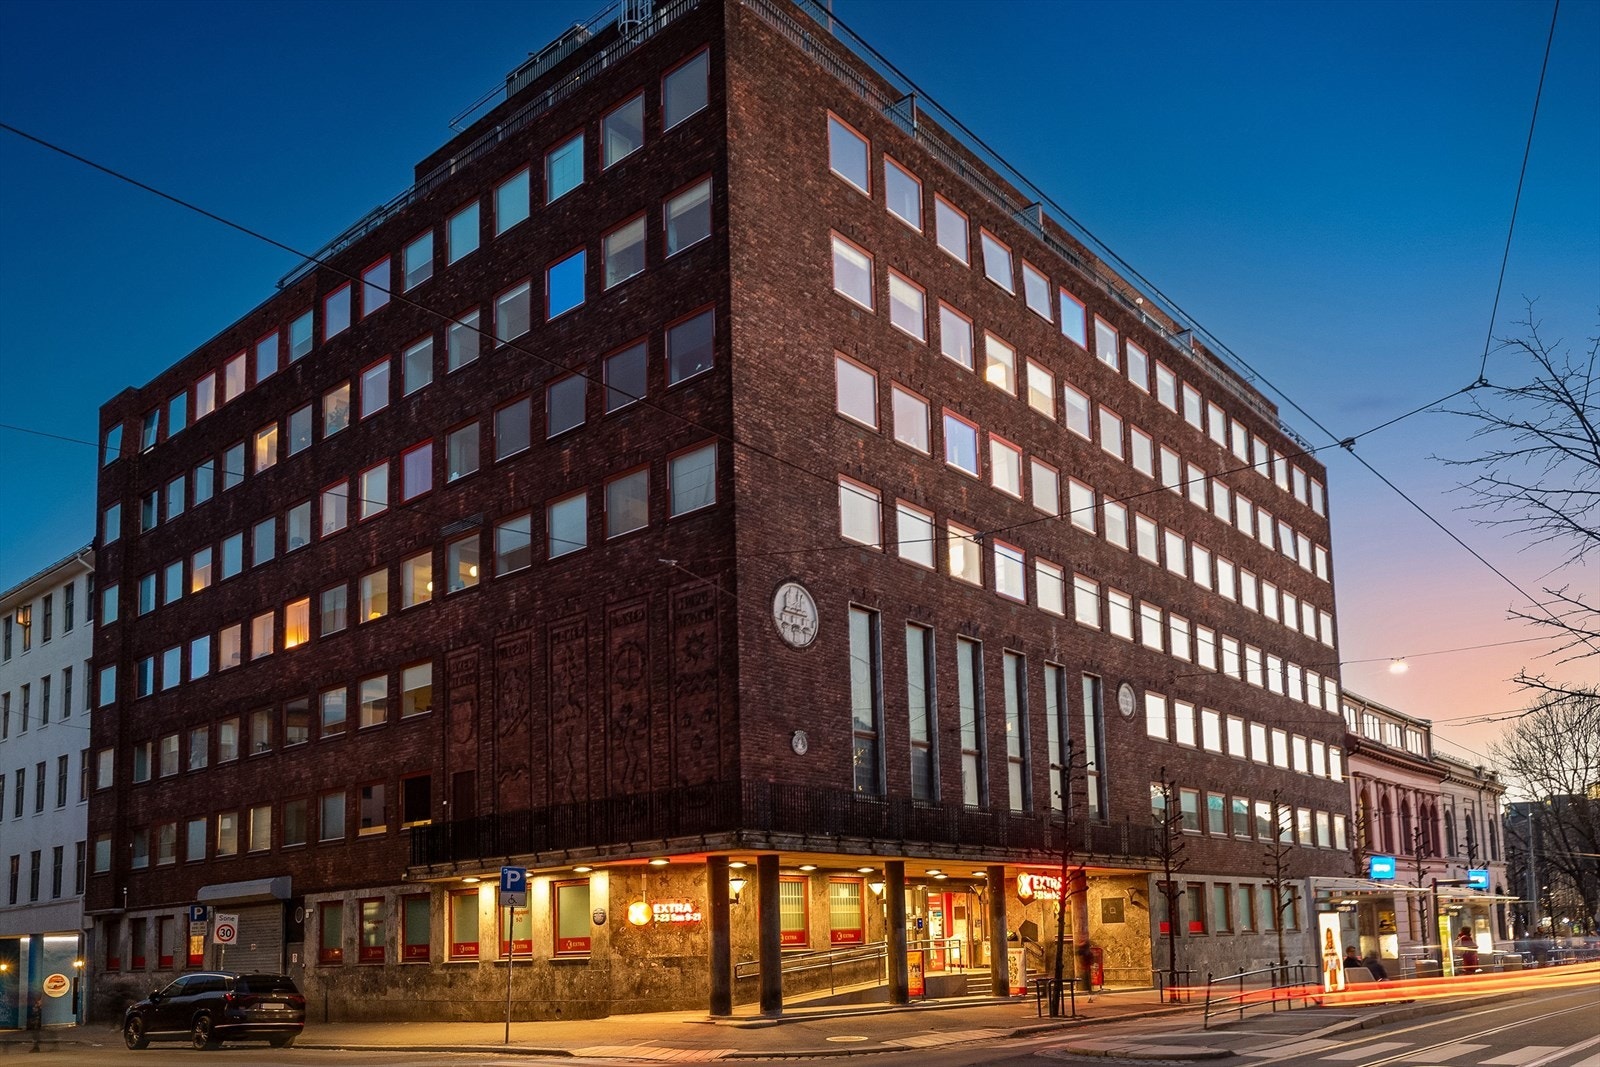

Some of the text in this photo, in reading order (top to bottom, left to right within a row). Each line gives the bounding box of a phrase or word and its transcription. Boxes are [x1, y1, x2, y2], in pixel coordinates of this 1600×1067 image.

[506, 870, 521, 889] P
[1033, 875, 1062, 890] EXTRA
[194, 906, 204, 920] P
[653, 904, 692, 913] EXTRA
[220, 928, 232, 938] 30
